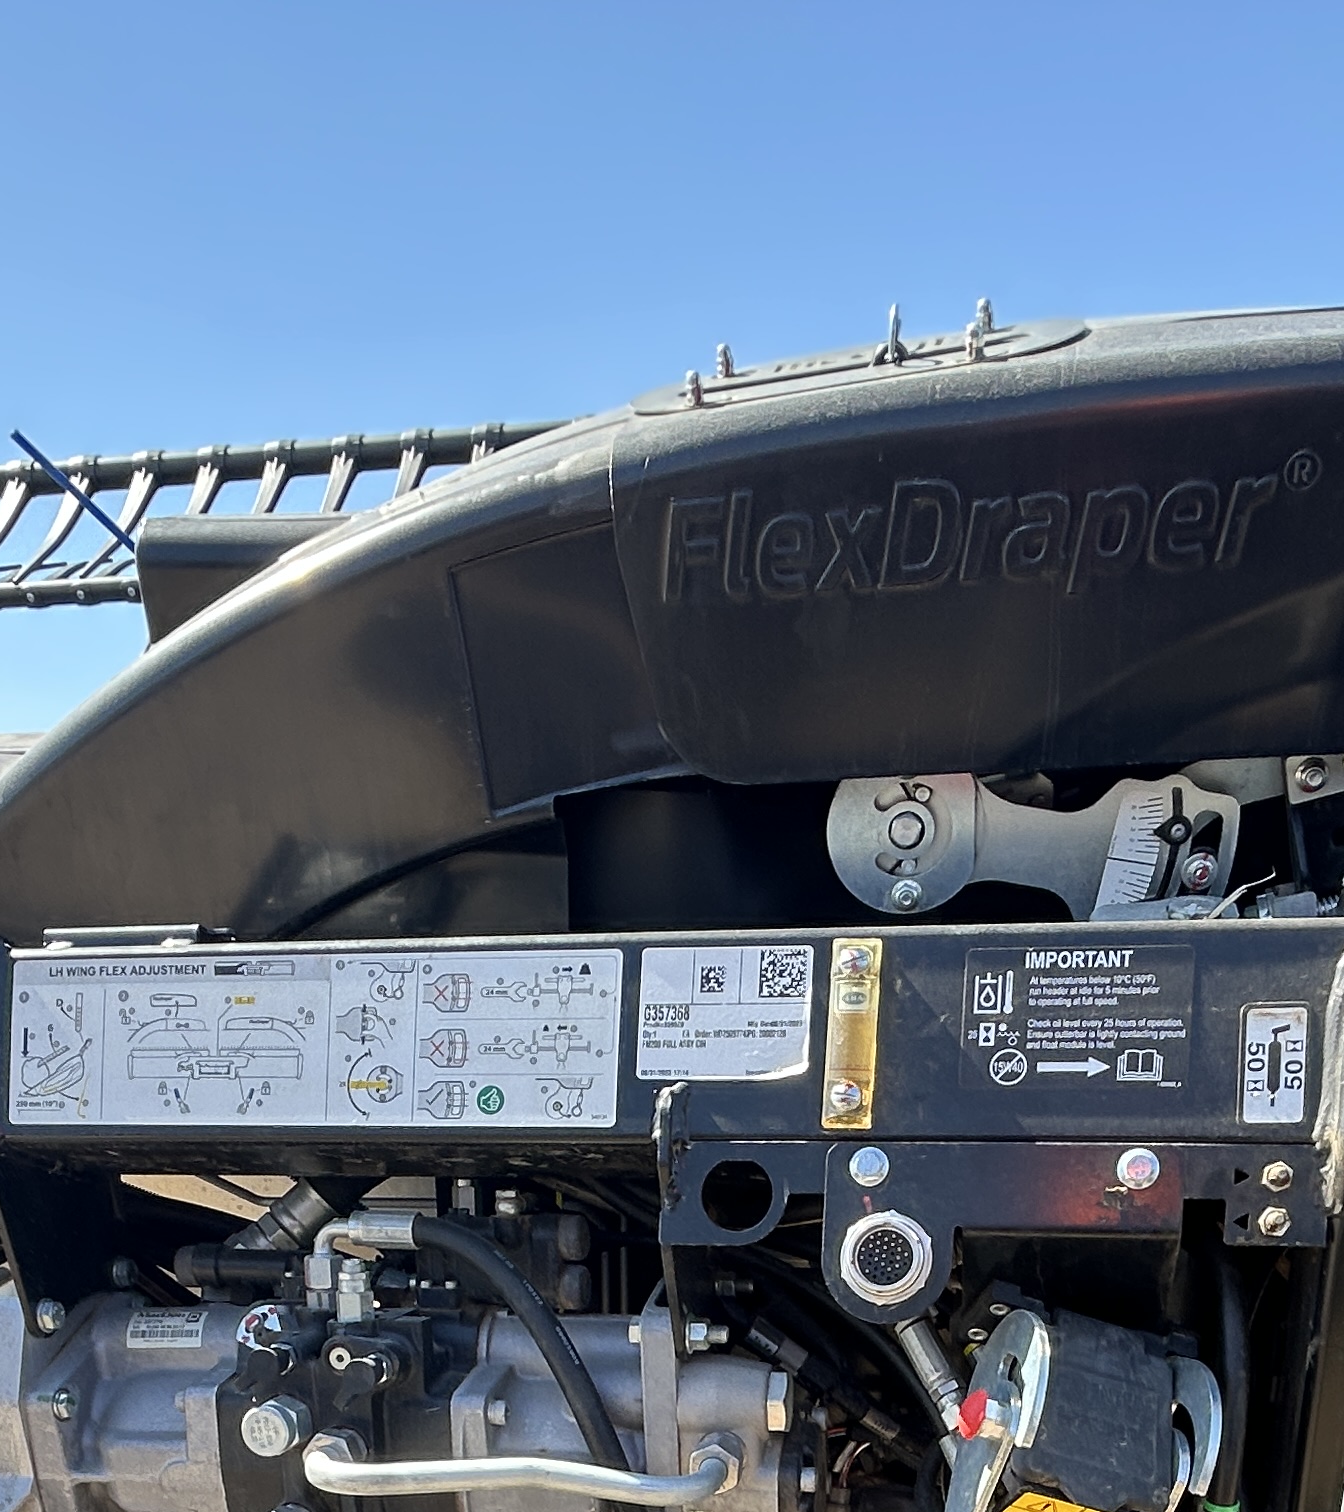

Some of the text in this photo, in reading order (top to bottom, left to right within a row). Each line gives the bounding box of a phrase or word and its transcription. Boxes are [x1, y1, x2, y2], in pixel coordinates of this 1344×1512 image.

[1024, 950, 1134, 969] IMPORTANT
[49, 964, 207, 977] LH WING FLEX ADJUSTMENT
[1040, 975, 1087, 986] temperatures
[1088, 975, 1111, 985] below
[1043, 986, 1068, 995] header
[1112, 985, 1141, 995] minutes
[1037, 997, 1072, 1008] operating
[644, 1003, 690, 1021] G357368
[1027, 1019, 1051, 1028] Check
[1063, 1018, 1080, 1027] level
[1082, 1019, 1102, 1029] every
[1103, 1018, 1114, 1027] 25
[1115, 1018, 1136, 1028] hours
[1246, 1042, 1266, 1072] 50
[1284, 1059, 1304, 1091] 50
